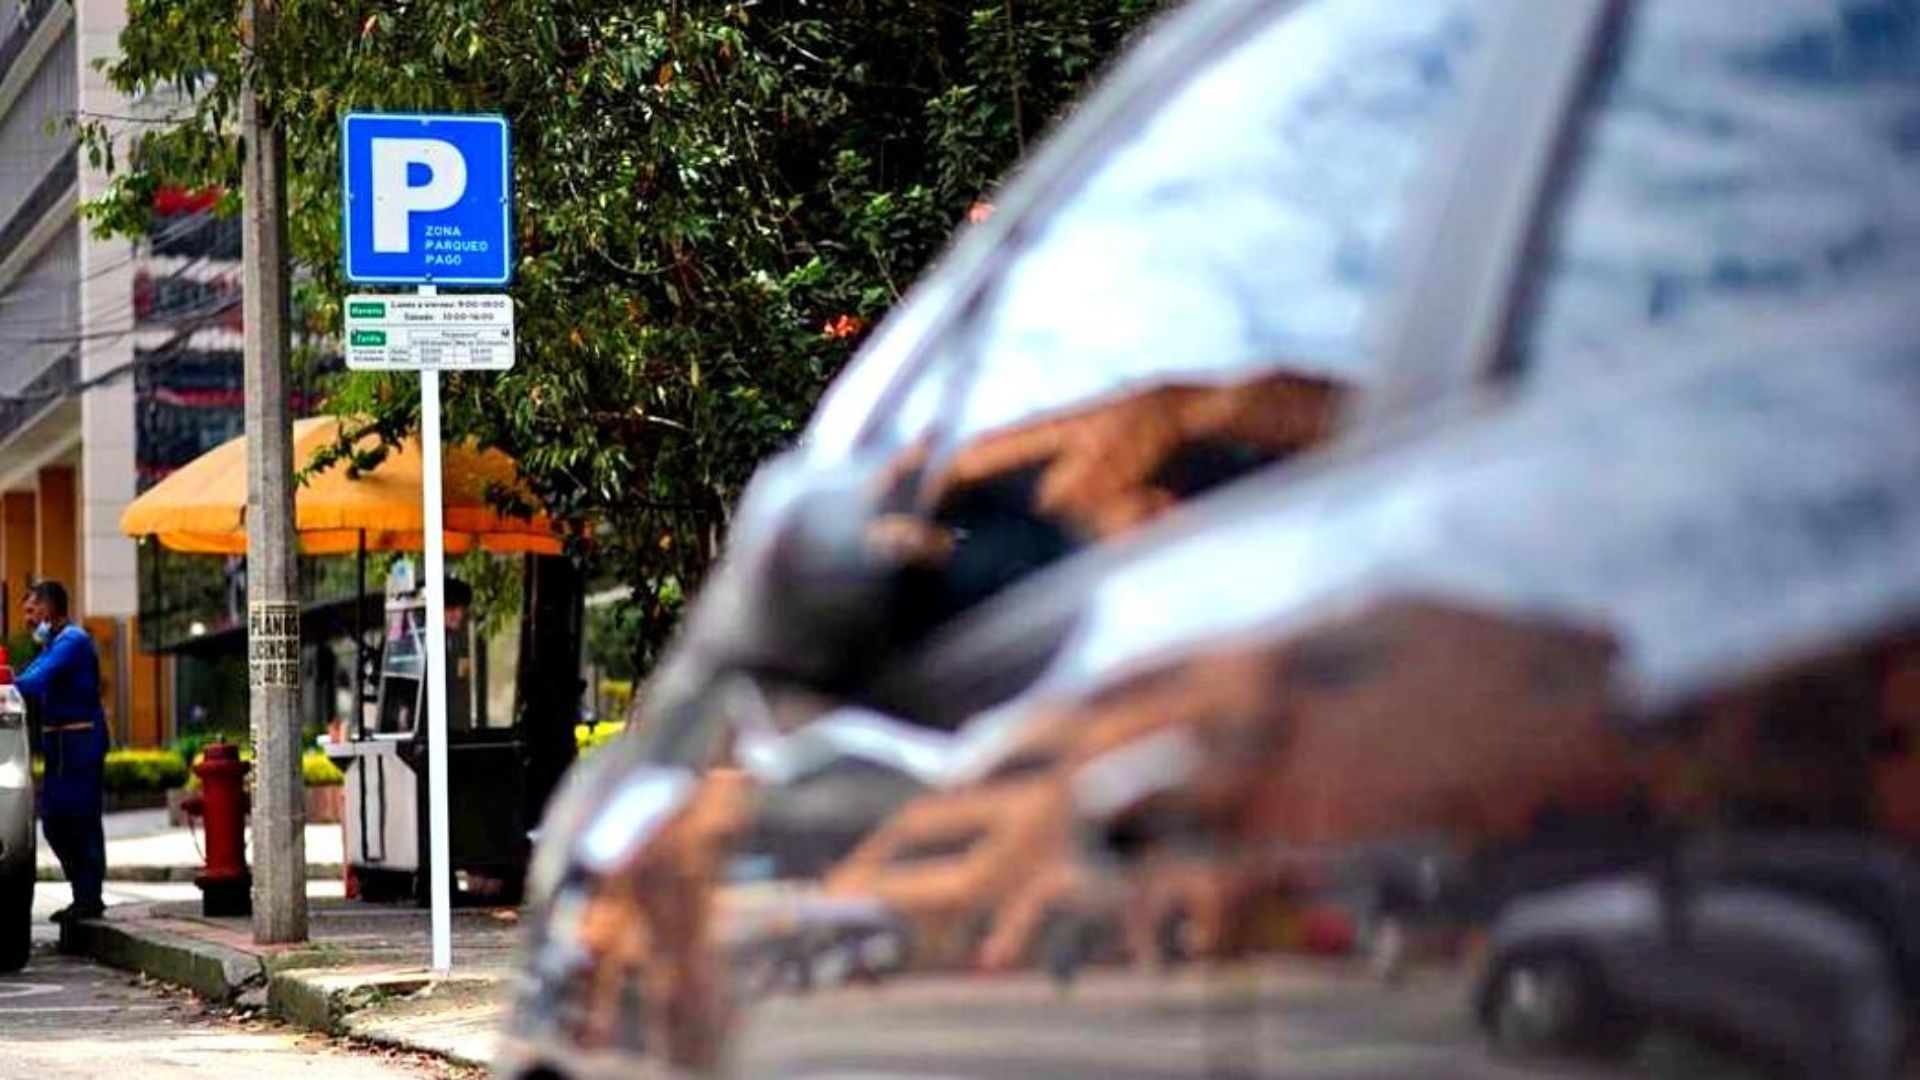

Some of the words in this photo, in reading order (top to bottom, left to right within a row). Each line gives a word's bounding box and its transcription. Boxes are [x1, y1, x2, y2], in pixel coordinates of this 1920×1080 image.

[371, 137, 467, 253] P
[425, 225, 461, 237] ZONA
[425, 240, 489, 252] PARQUEO
[425, 253, 462, 266] PAGO
